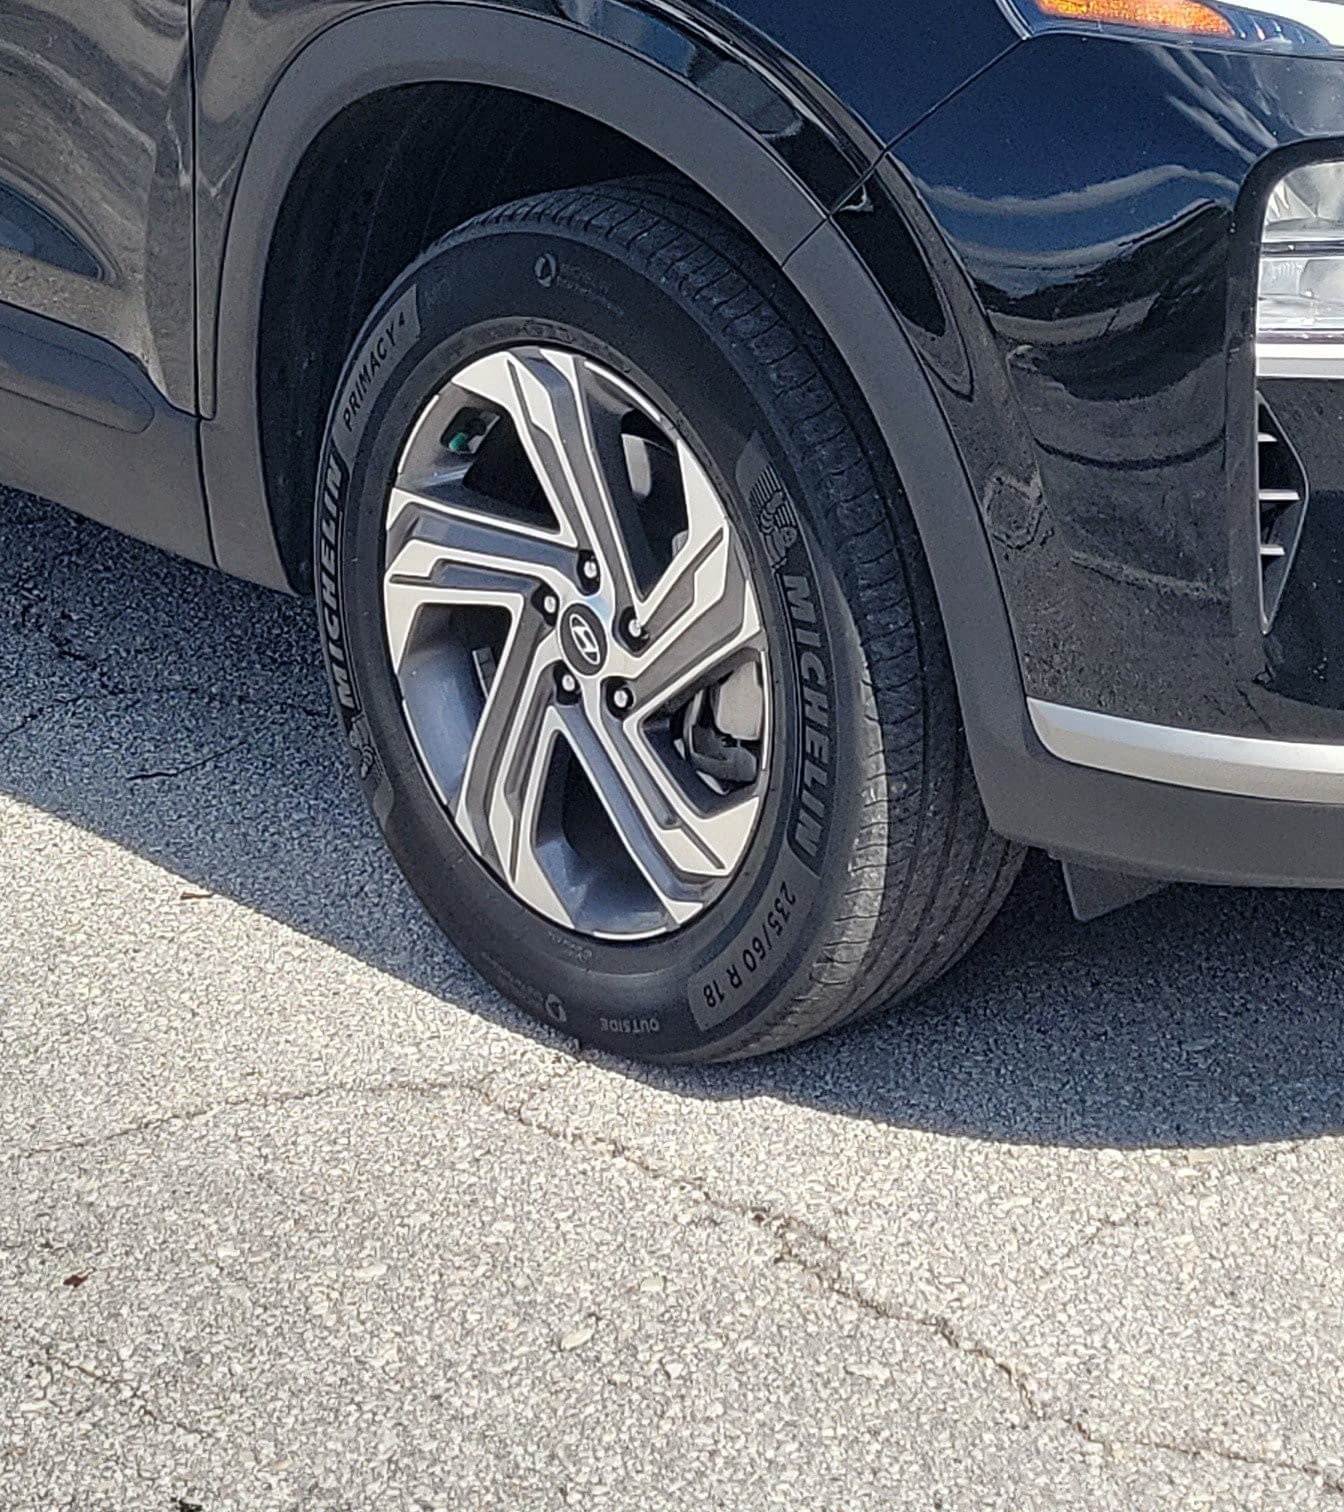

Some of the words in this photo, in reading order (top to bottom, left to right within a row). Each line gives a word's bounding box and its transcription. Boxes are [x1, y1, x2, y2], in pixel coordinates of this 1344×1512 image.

[343, 321, 397, 432] PRIMACY
[320, 452, 355, 710] MICHELIN
[783, 574, 830, 858] MICHELIN
[742, 881, 796, 973] 235/60
[703, 980, 725, 1008] 18
[726, 964, 743, 989] R
[599, 1017, 660, 1034] OUTSIDE
